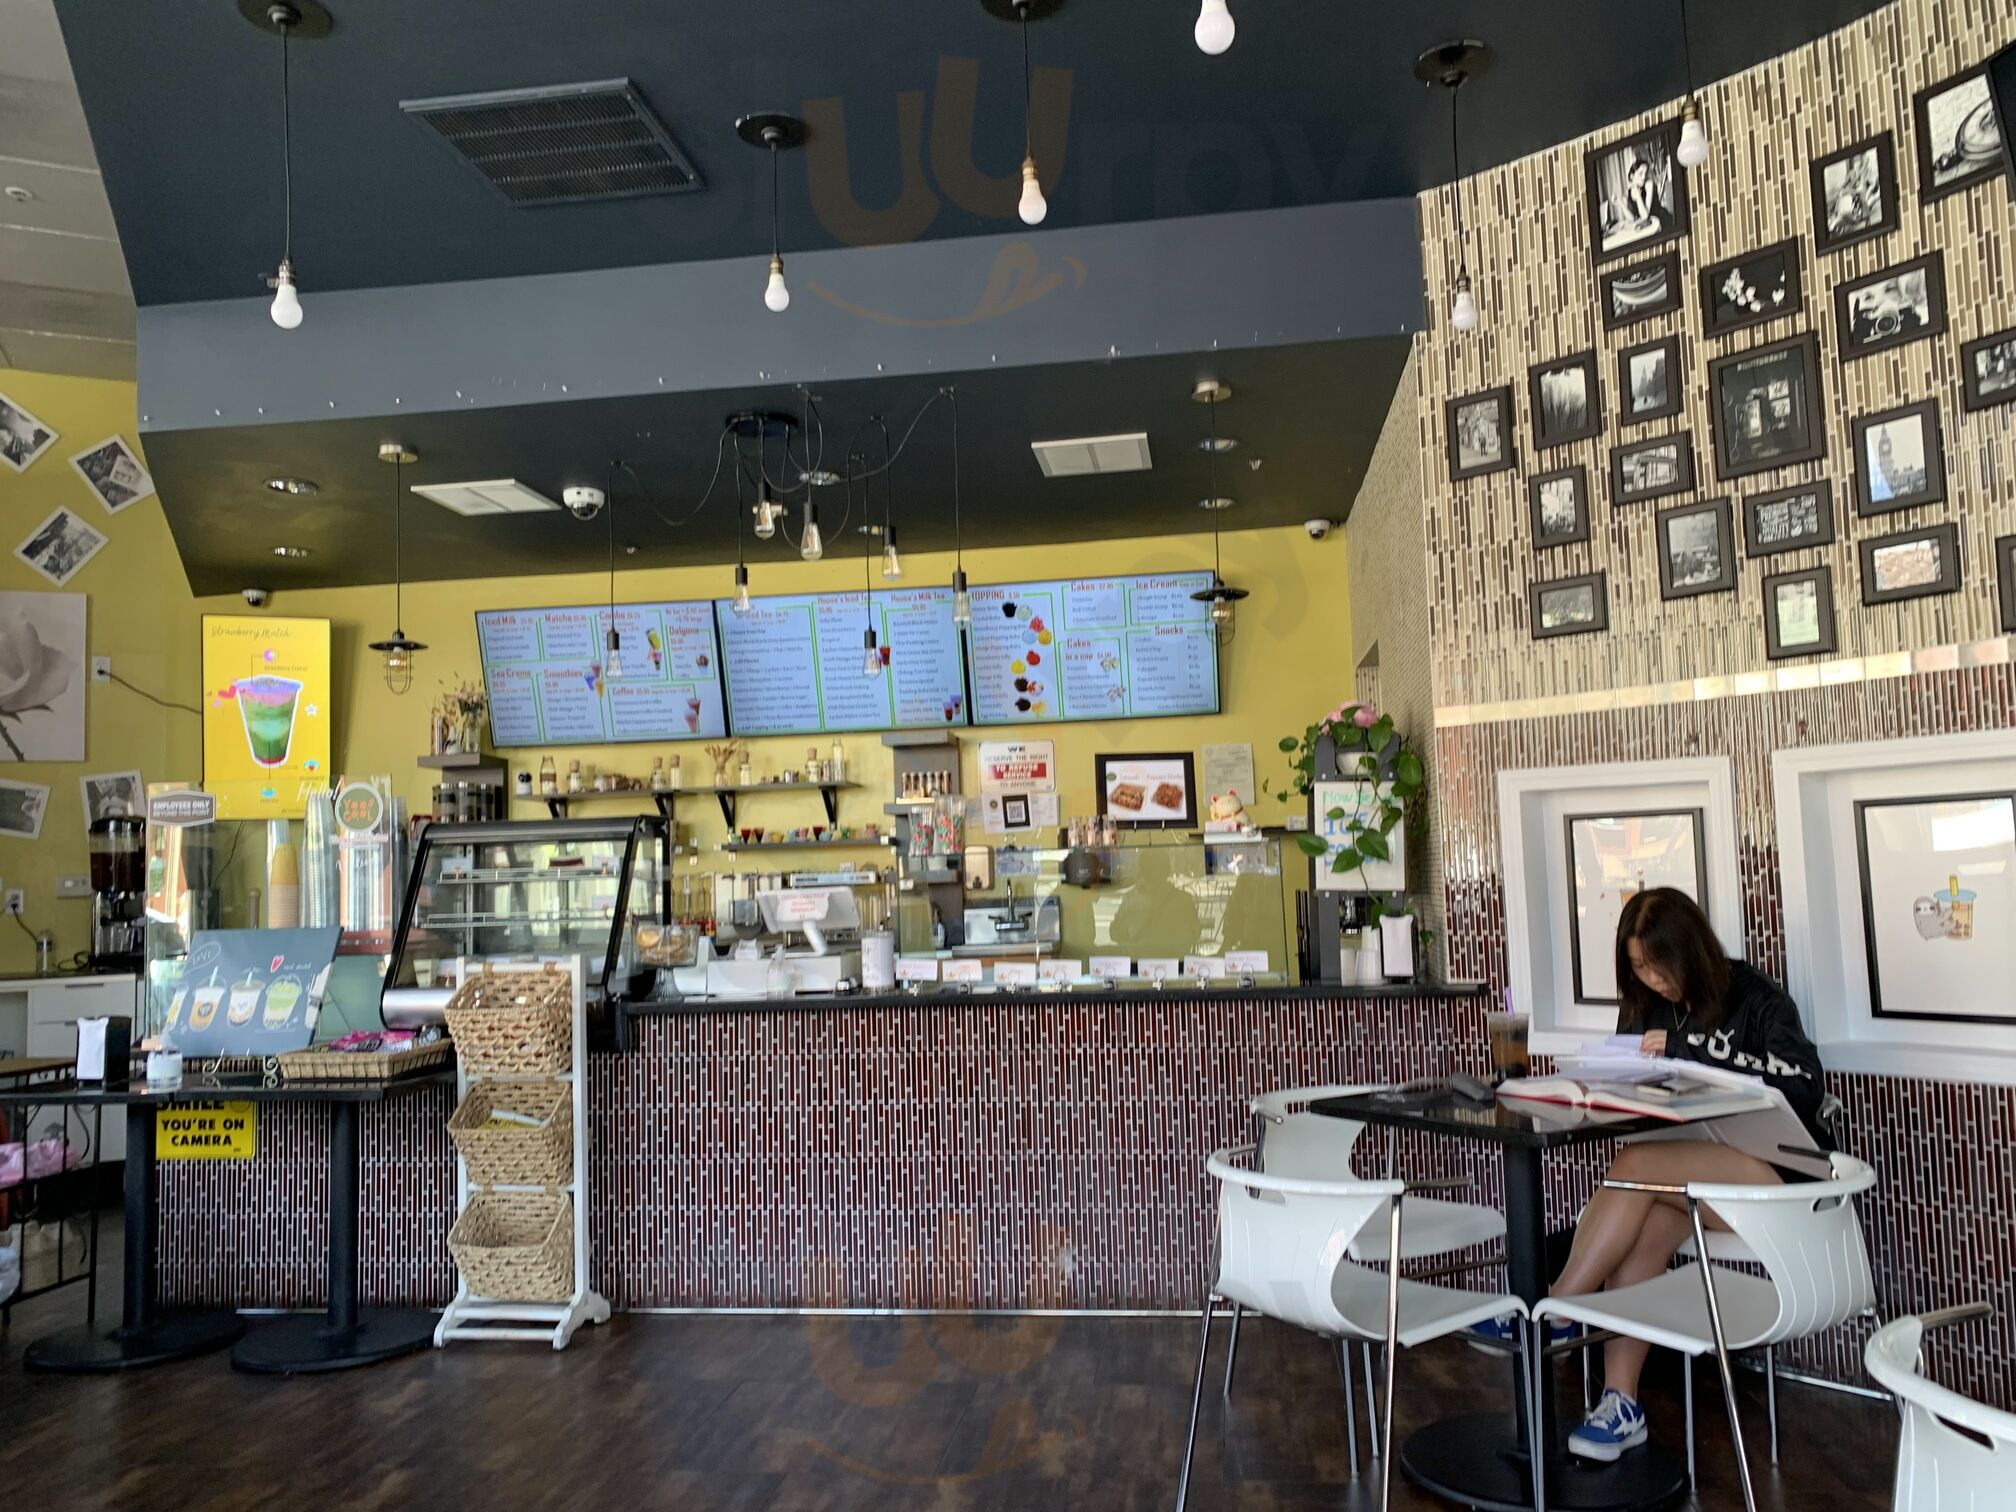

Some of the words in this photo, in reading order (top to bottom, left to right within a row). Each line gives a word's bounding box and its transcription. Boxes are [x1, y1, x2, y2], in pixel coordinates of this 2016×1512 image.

[1071, 581, 1095, 592] Cakes
[1136, 580, 1148, 590] Ice
[1150, 579, 1177, 589] Cream
[972, 589, 1004, 600] TOPPING
[545, 614, 572, 622] Matcha
[1155, 626, 1184, 636] Snacks
[1067, 638, 1091, 648] Cakes
[153, 800, 191, 810] EMPLOYEES
[192, 800, 210, 809] ONLY
[162, 1118, 215, 1131] YOU'RE
[223, 1118, 244, 1130] ON
[171, 1135, 232, 1146] CAMERA
